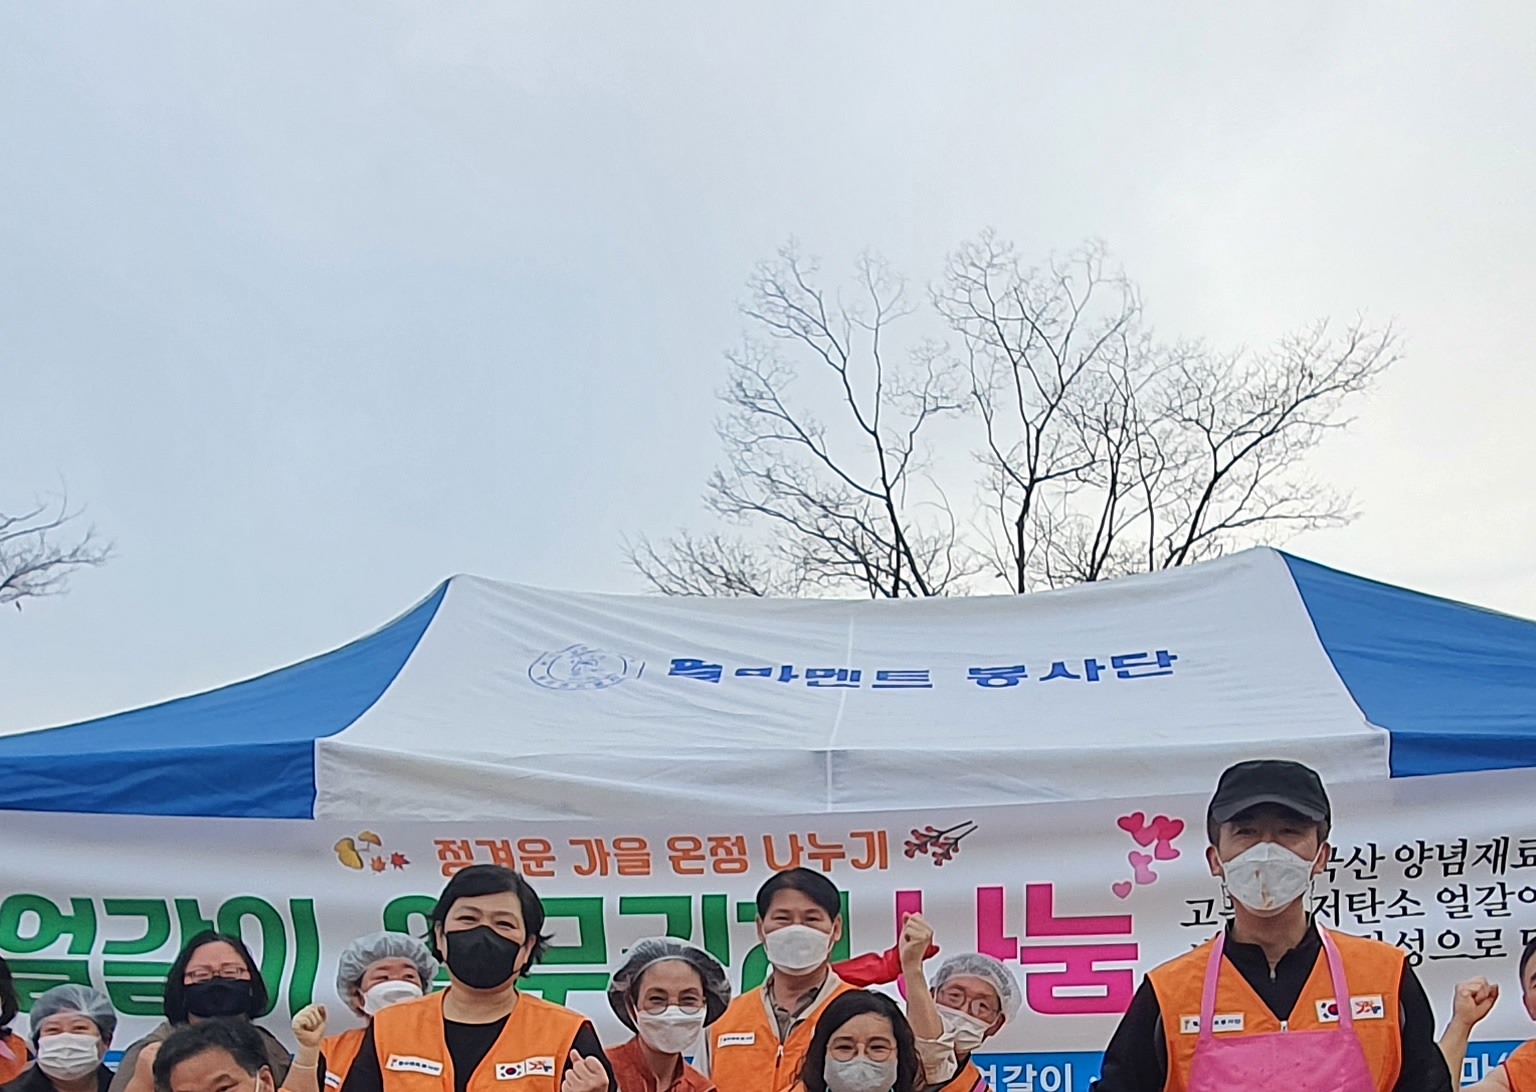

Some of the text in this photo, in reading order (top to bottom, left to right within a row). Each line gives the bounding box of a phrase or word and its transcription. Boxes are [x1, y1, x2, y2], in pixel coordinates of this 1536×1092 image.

[966, 650, 1178, 689] 봉사단
[432, 829, 890, 878] 정겨운 가을 온정 나누기
